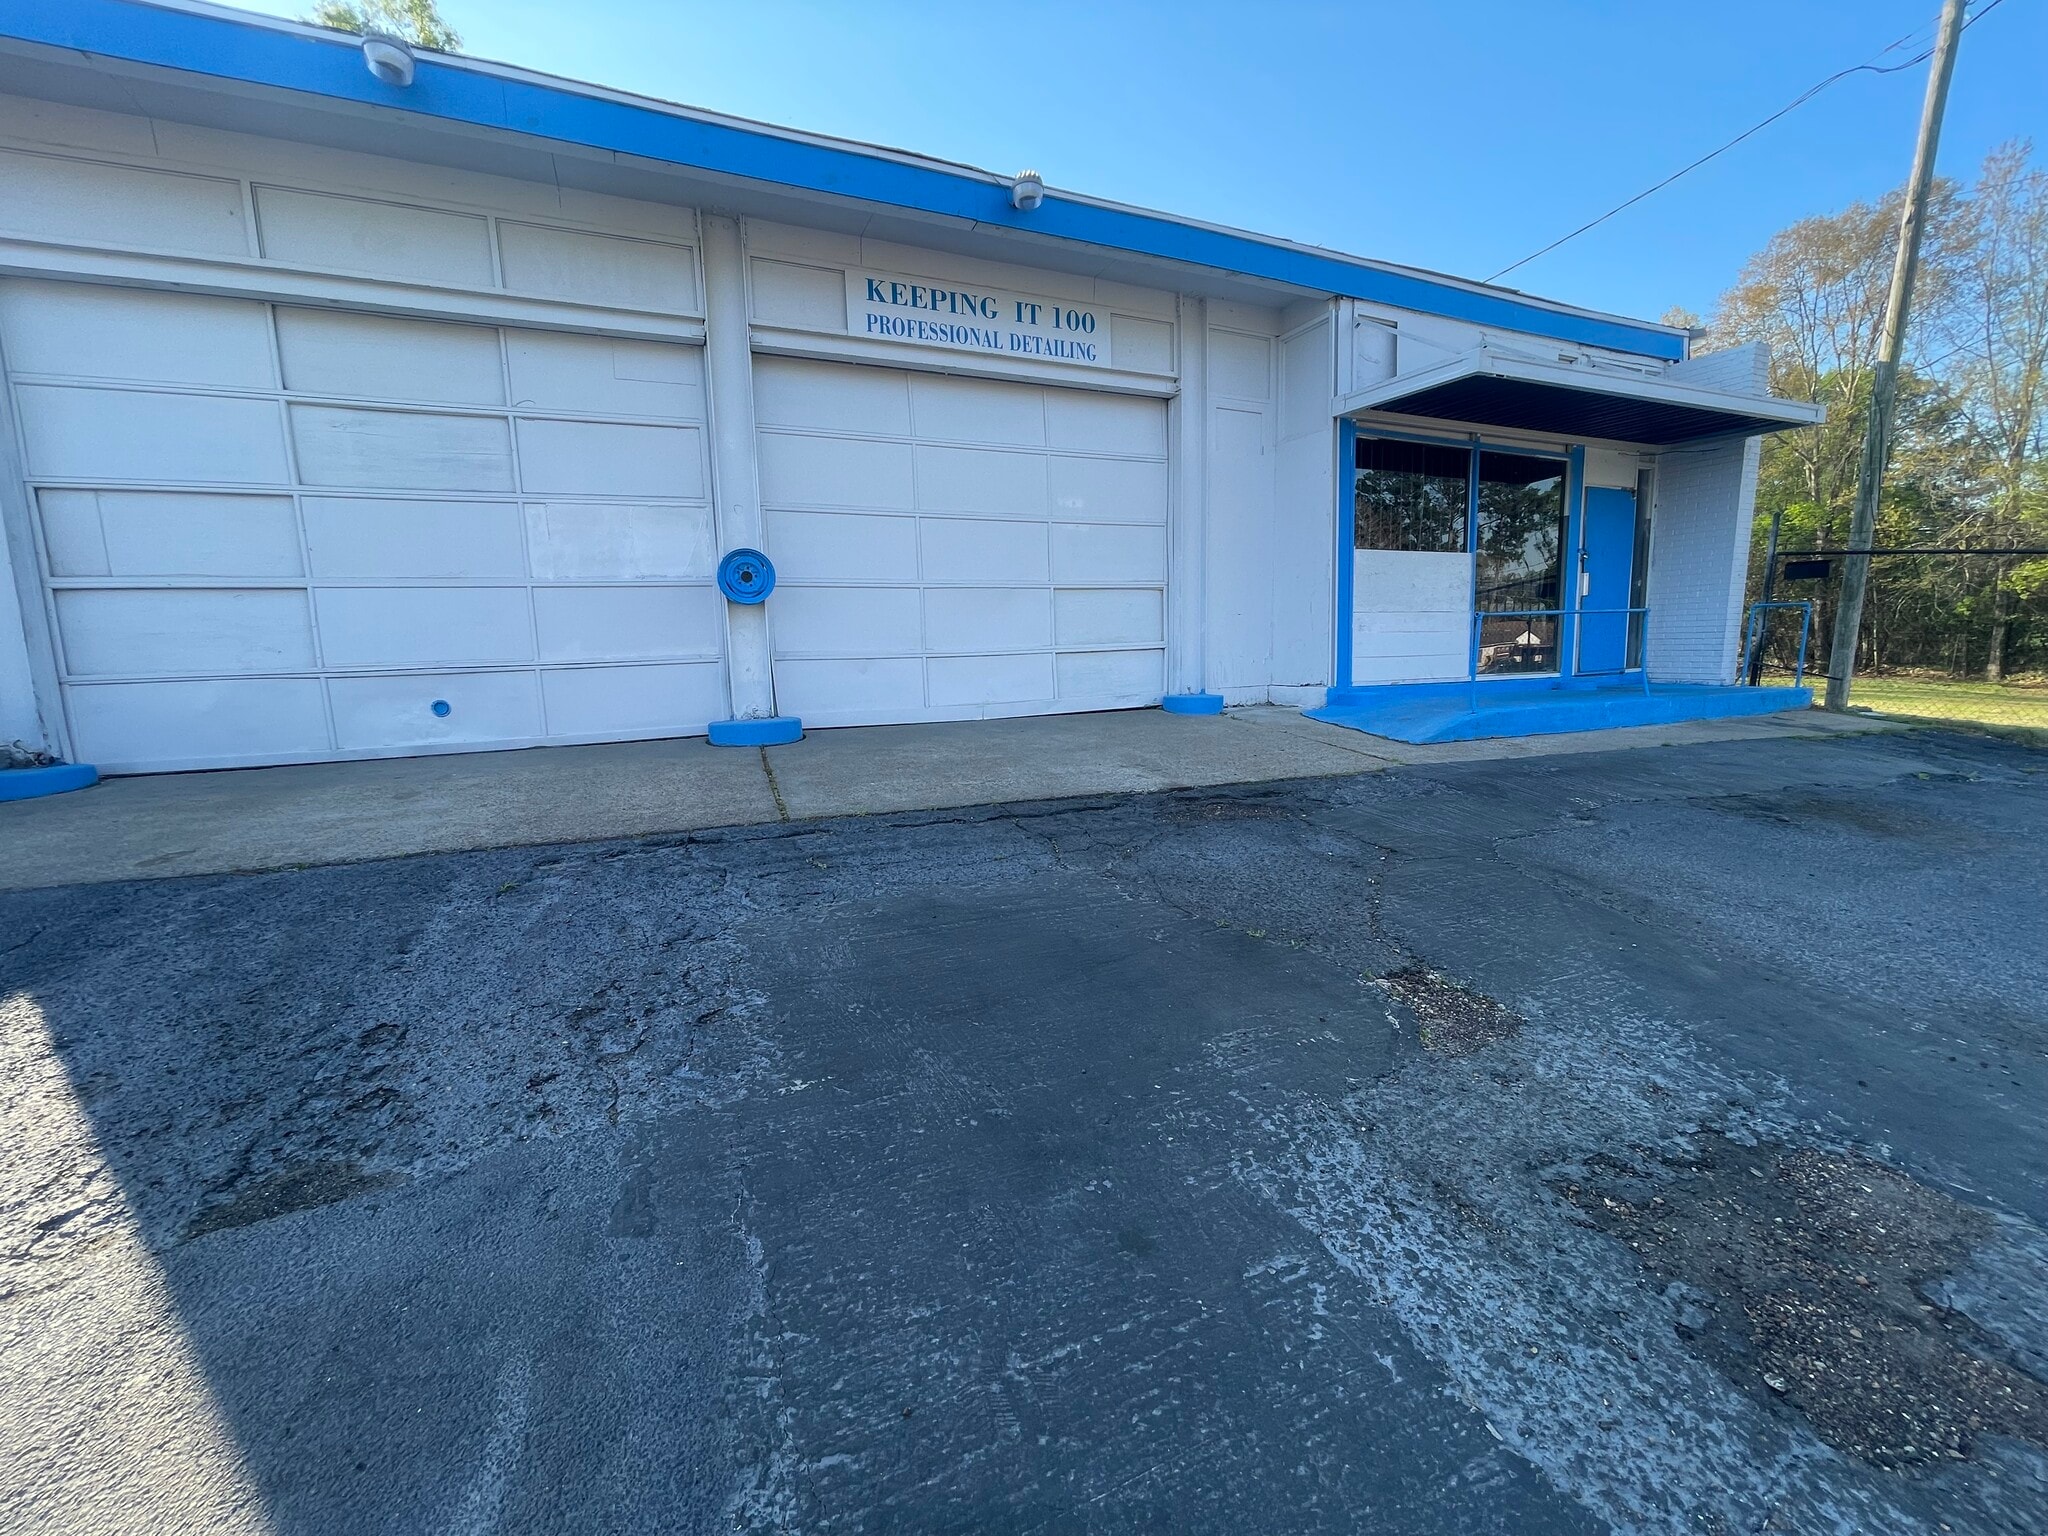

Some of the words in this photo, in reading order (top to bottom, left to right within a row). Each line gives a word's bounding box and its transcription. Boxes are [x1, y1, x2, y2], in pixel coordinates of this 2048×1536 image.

[865, 277, 999, 320] KEEPING
[1015, 300, 1042, 326] IT
[1052, 306, 1096, 334] 100
[866, 312, 1004, 349] PROFESSIONAL
[1009, 332, 1097, 362] DETAILING
